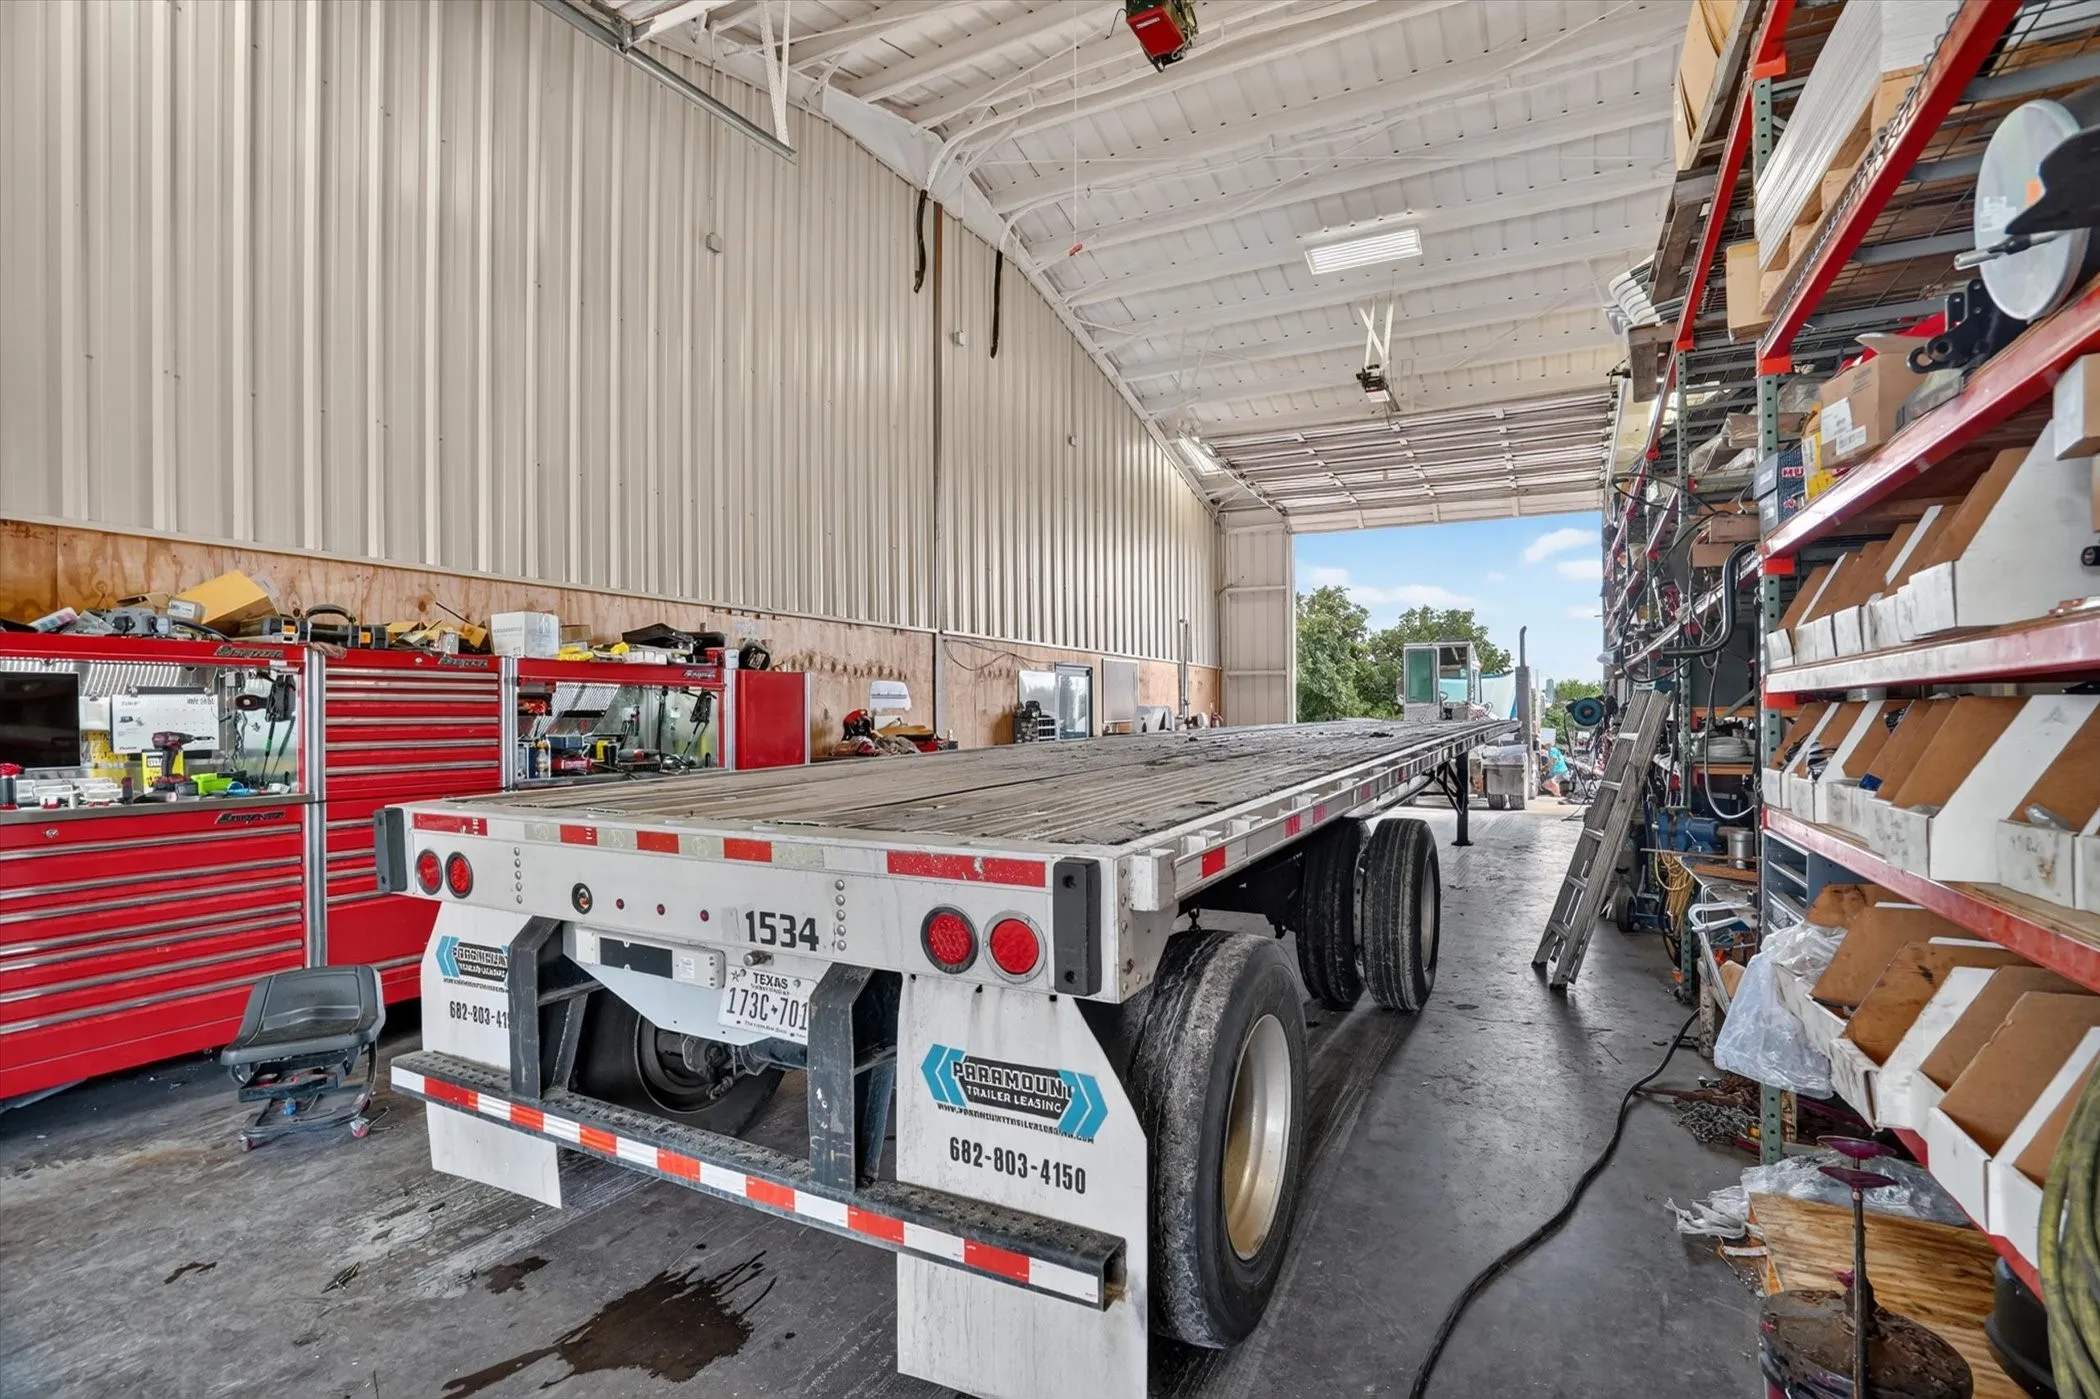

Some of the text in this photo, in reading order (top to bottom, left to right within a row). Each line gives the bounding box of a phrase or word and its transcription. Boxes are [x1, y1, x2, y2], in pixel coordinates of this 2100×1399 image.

[1781, 466, 1805, 478] MU
[745, 910, 819, 952] 1534
[753, 972, 788, 989] TEXAS
[449, 1000, 510, 1029] 682-803-41
[952, 1061, 1074, 1099] PARAMOUNT
[966, 1086, 1062, 1113] TRAILER LEASING
[949, 1137, 1086, 1195] 682-803-4150
